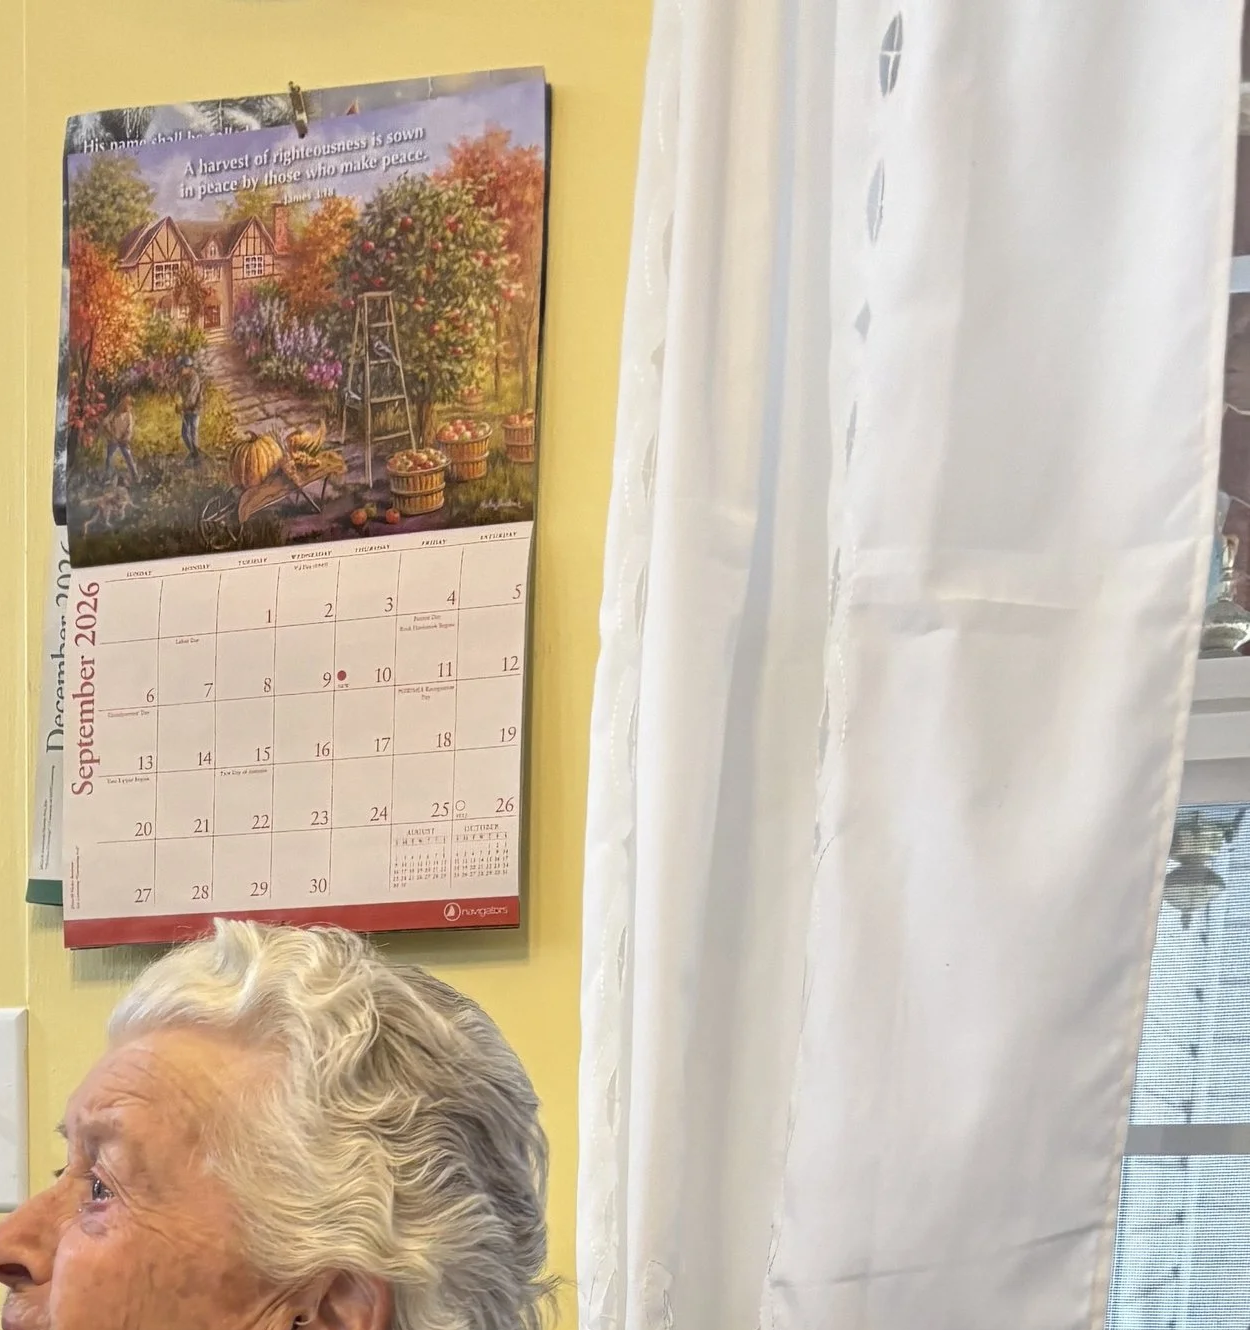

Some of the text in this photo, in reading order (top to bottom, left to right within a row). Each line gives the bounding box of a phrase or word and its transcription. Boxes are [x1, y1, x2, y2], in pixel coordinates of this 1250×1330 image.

[83, 138, 105, 154] His
[184, 127, 424, 175] A harvest of righteousness is sown
[180, 151, 428, 200] in peace by those who make peace.
[265, 584, 522, 624] 1 2 3 4 5
[71, 582, 101, 796] September 2026
[146, 655, 520, 703] 6 7 8 9 10 11 12
[138, 726, 517, 771] 13 14 15 16 17 18 19
[134, 797, 514, 837] 20 21 22 23 24 25 26
[134, 877, 327, 904] 27 28 29 30
